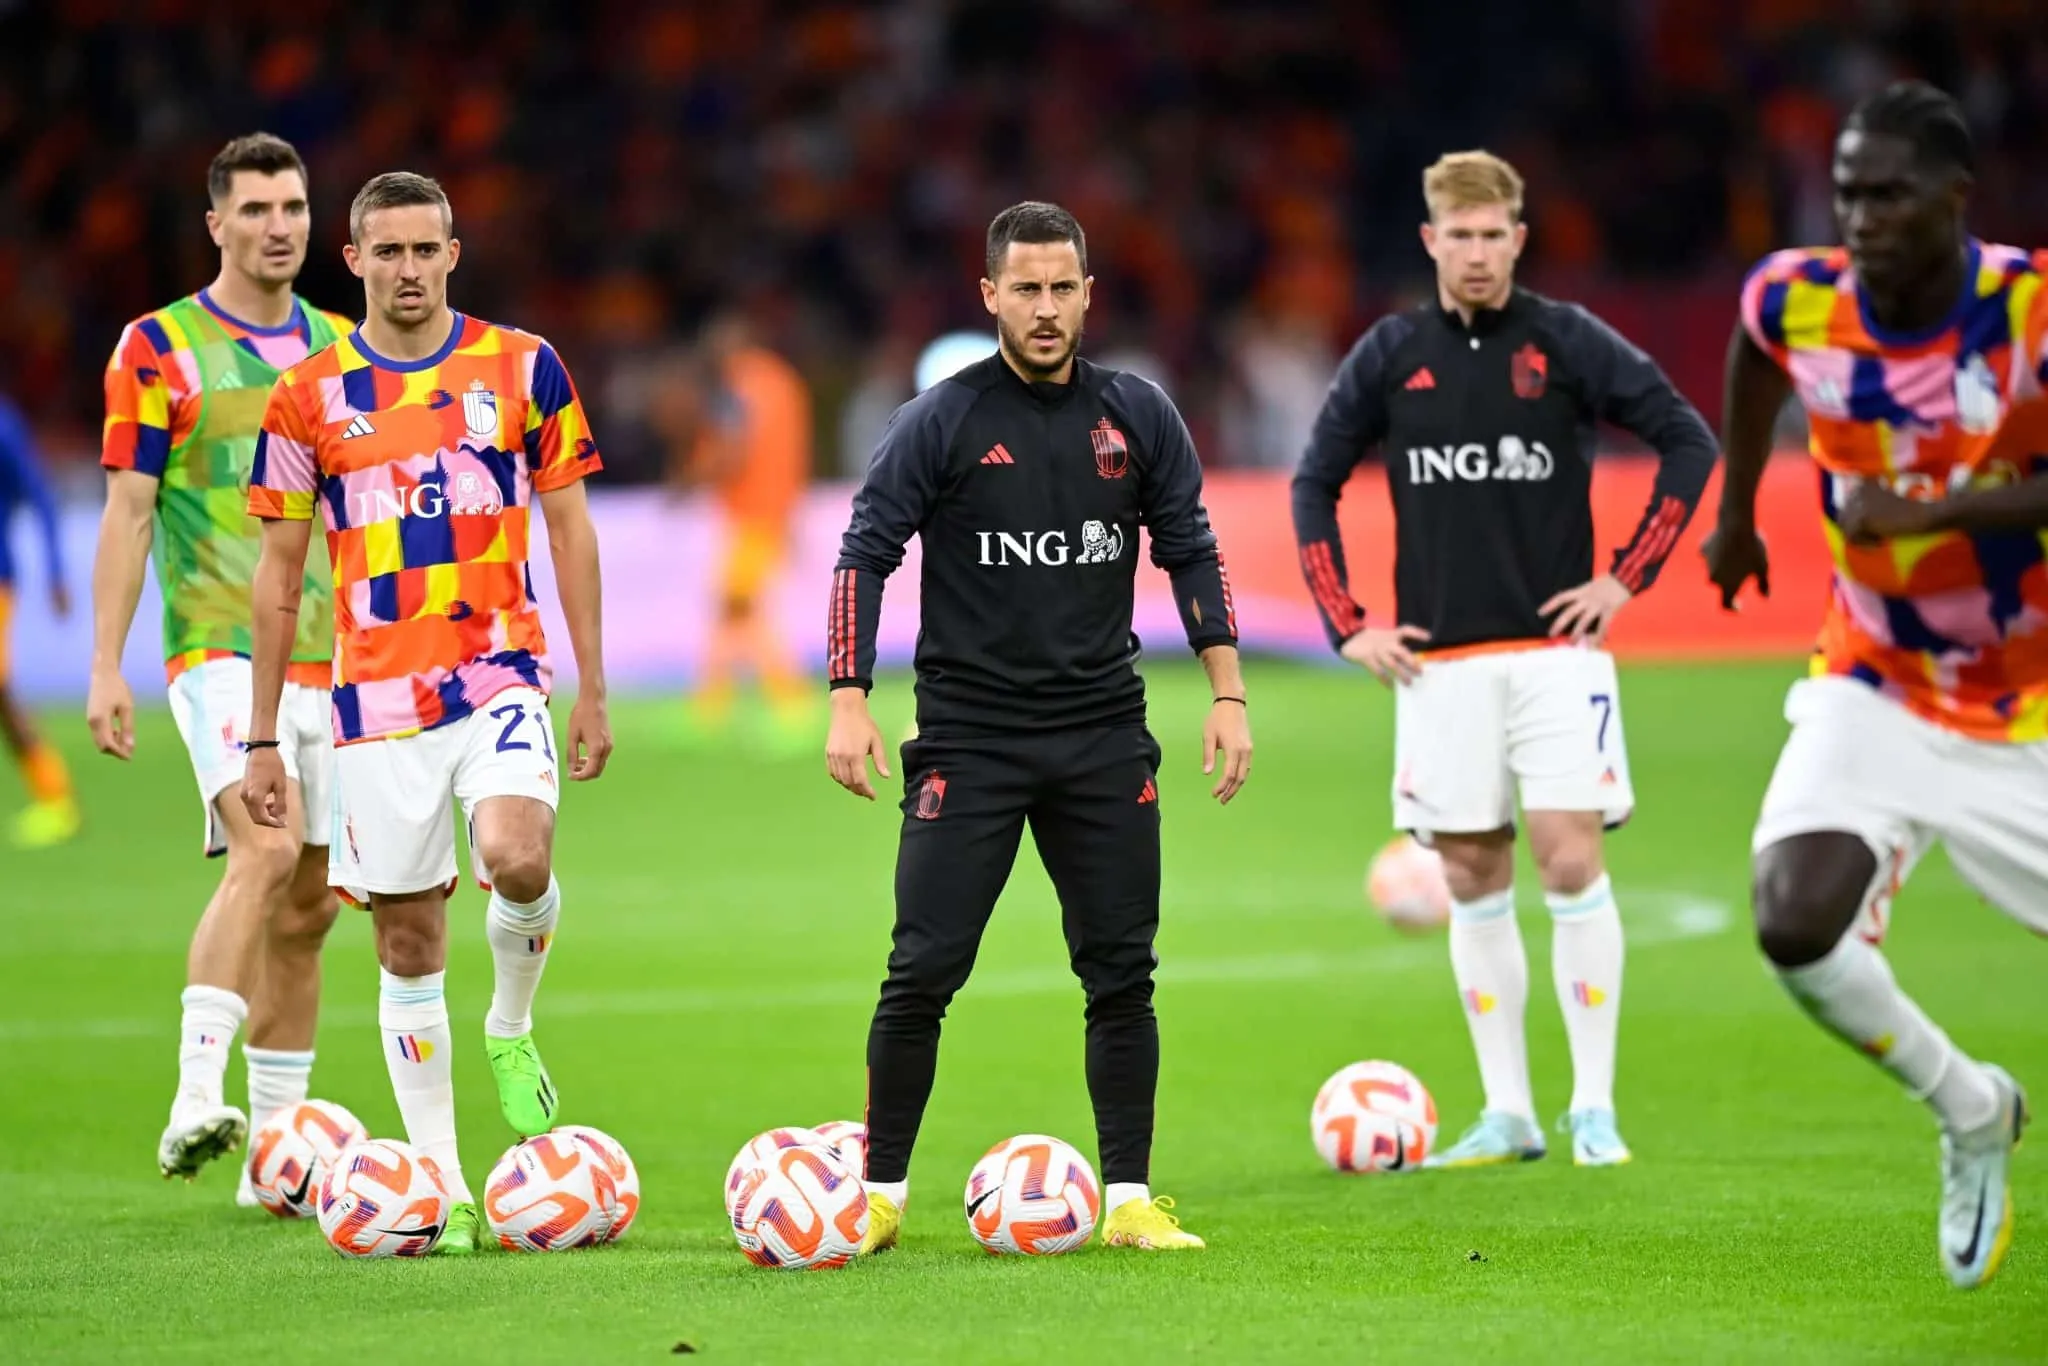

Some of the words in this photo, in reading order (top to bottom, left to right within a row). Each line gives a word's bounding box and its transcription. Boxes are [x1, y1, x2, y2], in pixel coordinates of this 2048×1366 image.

[1405, 443, 1490, 485] ING
[354, 482, 444, 526] ING
[975, 530, 1070, 566] ING
[489, 703, 554, 764] 21
[1589, 693, 1611, 752] 7
